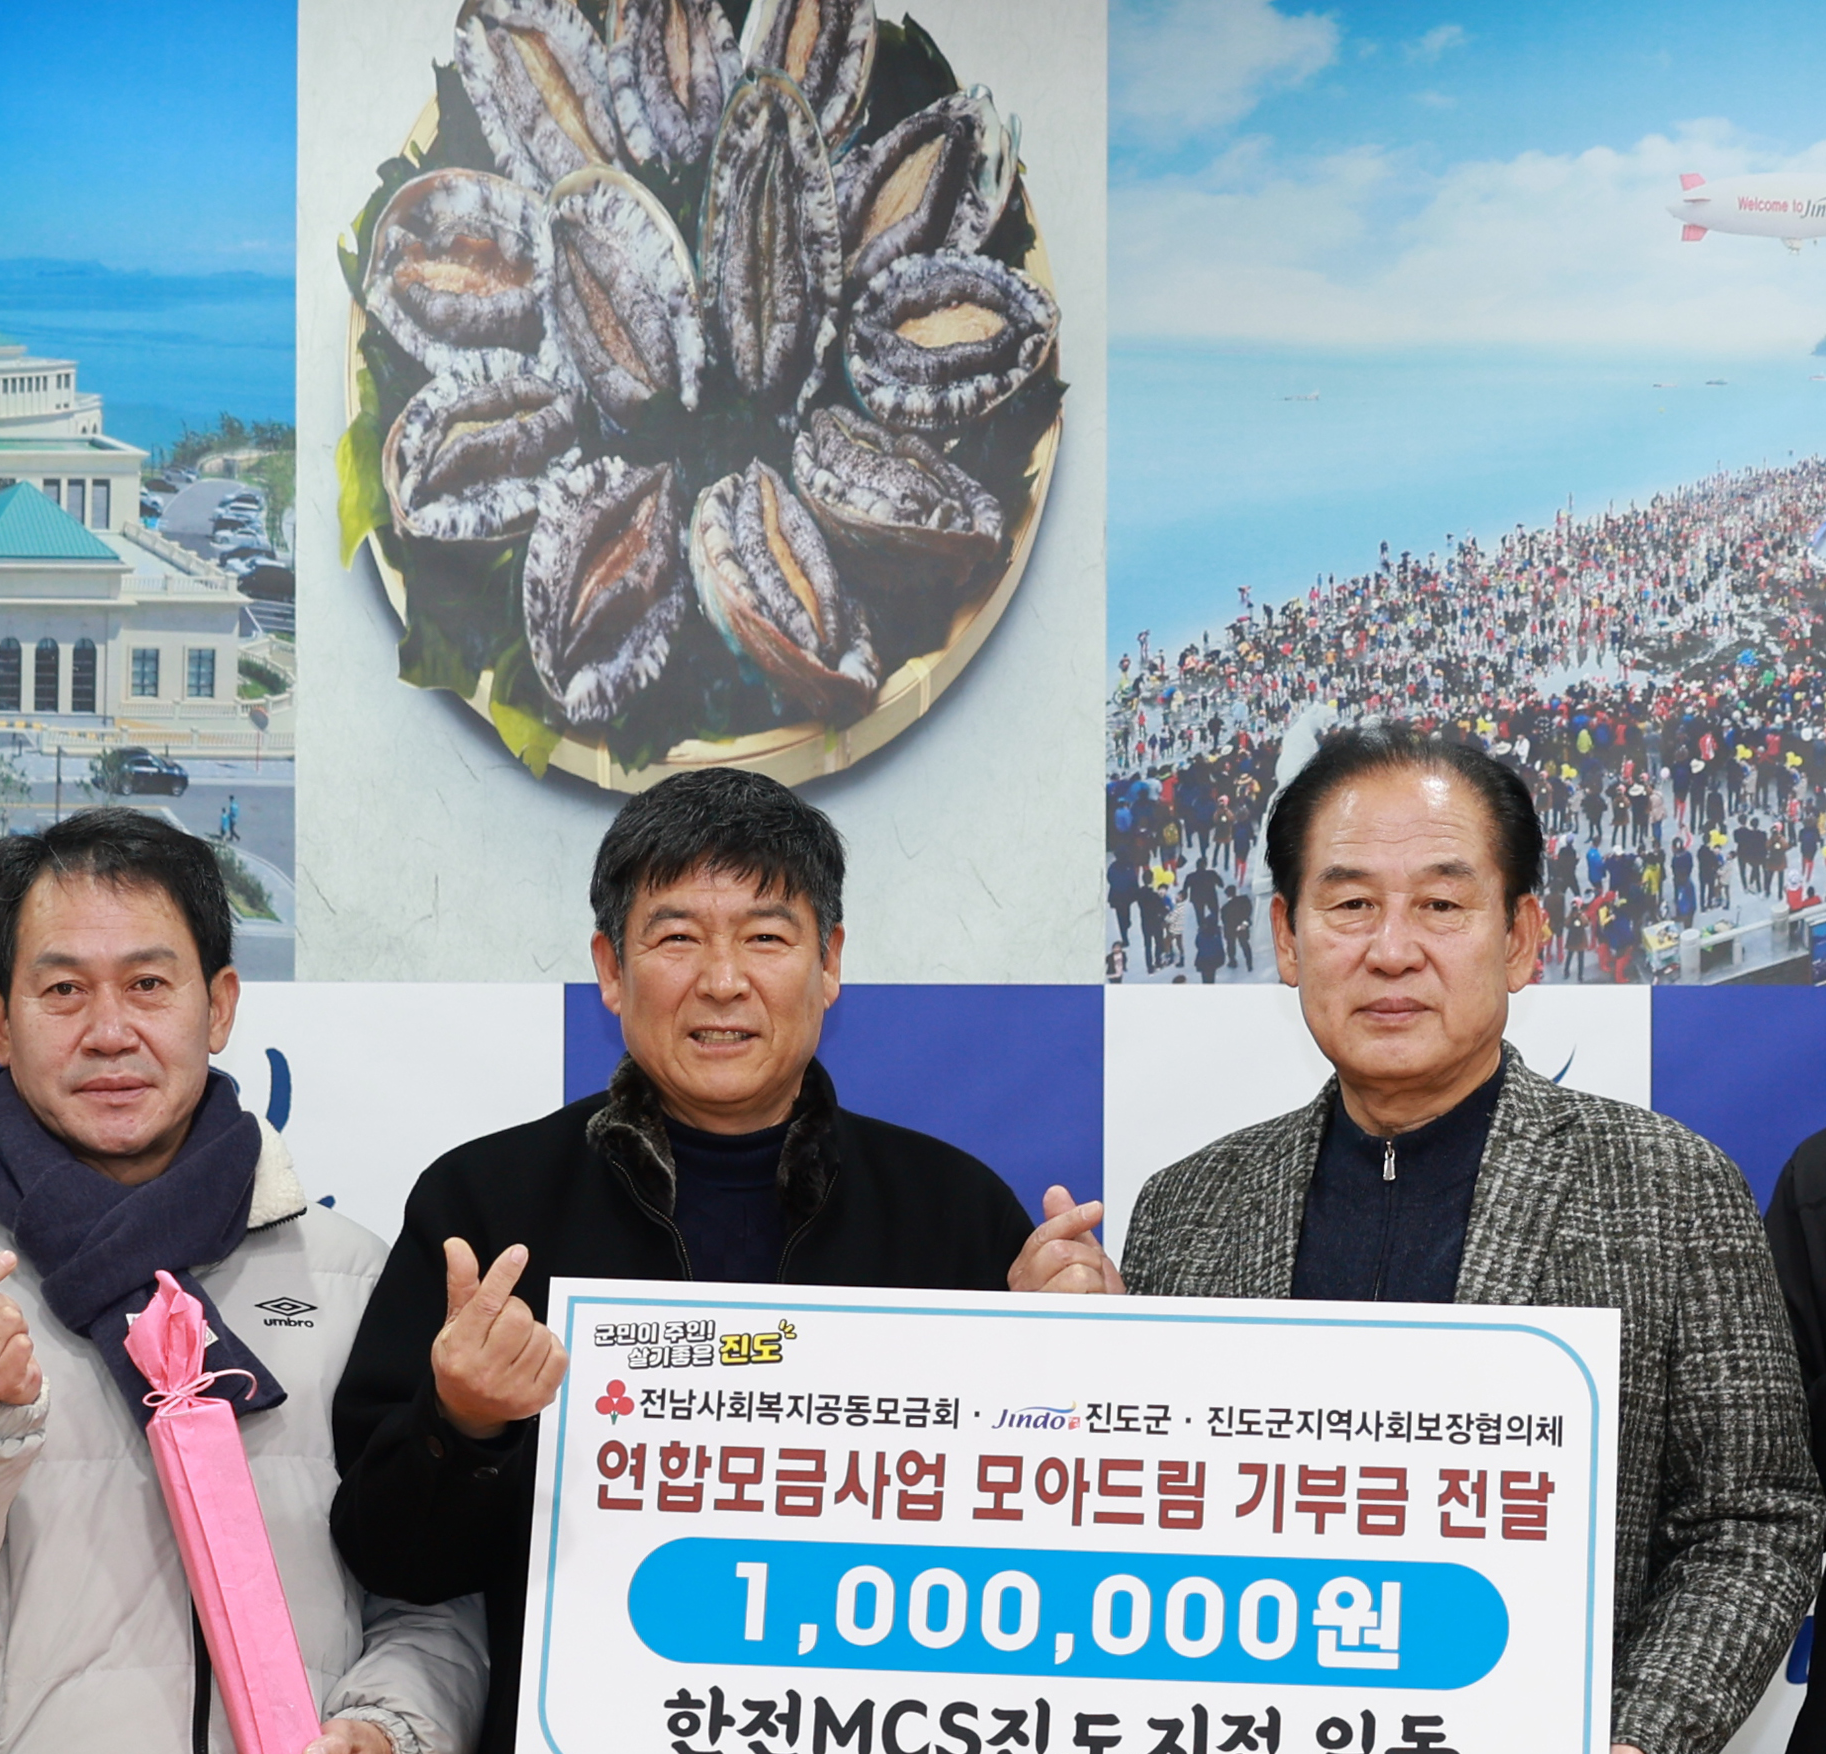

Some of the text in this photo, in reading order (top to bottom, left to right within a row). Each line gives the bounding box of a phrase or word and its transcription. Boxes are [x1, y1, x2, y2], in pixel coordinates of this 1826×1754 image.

[1737, 197, 1789, 213] Welcome
[1792, 199, 1804, 213] to
[263, 1317, 315, 1329] umbro
[594, 1319, 716, 1346] 군민이 주인!
[627, 1332, 784, 1369] 살기좋은 진도
[639, 1387, 1563, 1448] 전남사회복지공동모금회 Jindo 진도군 진도군지역사회보장협의체
[596, 1439, 1555, 1541] 연합모금사업 모아드림 기부금 전달
[734, 1561, 1401, 1671] 1,000,000원
